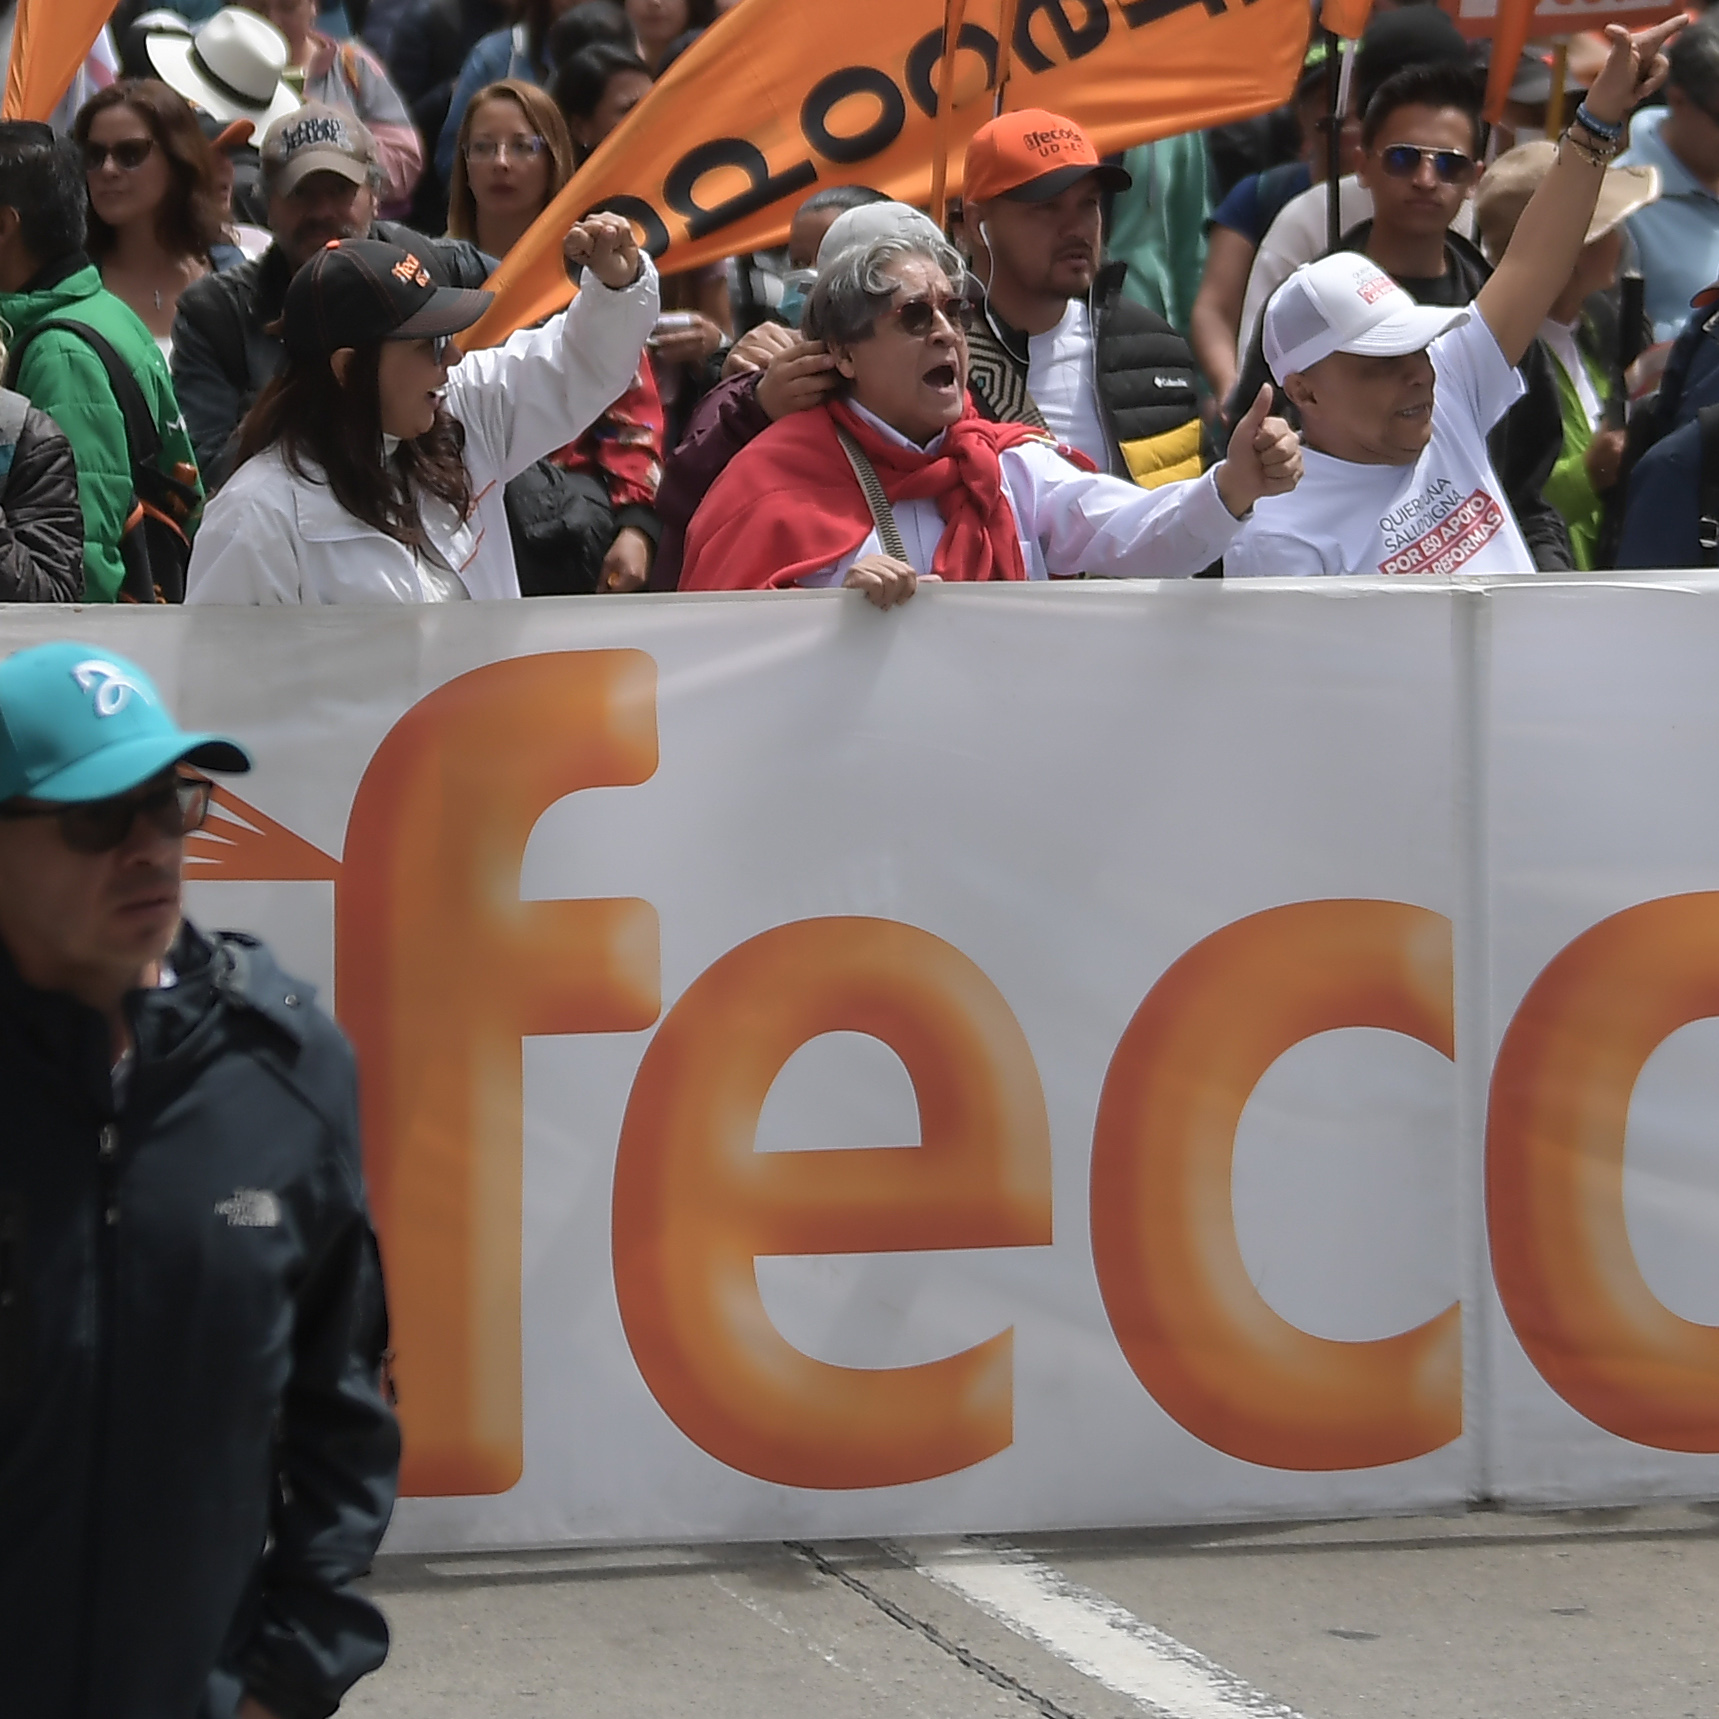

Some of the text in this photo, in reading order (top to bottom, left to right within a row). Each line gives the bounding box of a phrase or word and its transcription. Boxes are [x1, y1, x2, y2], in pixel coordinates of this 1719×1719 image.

[1384, 496, 1486, 574] POR ESO APOYO
[1431, 510, 1502, 574] REFORMAS
